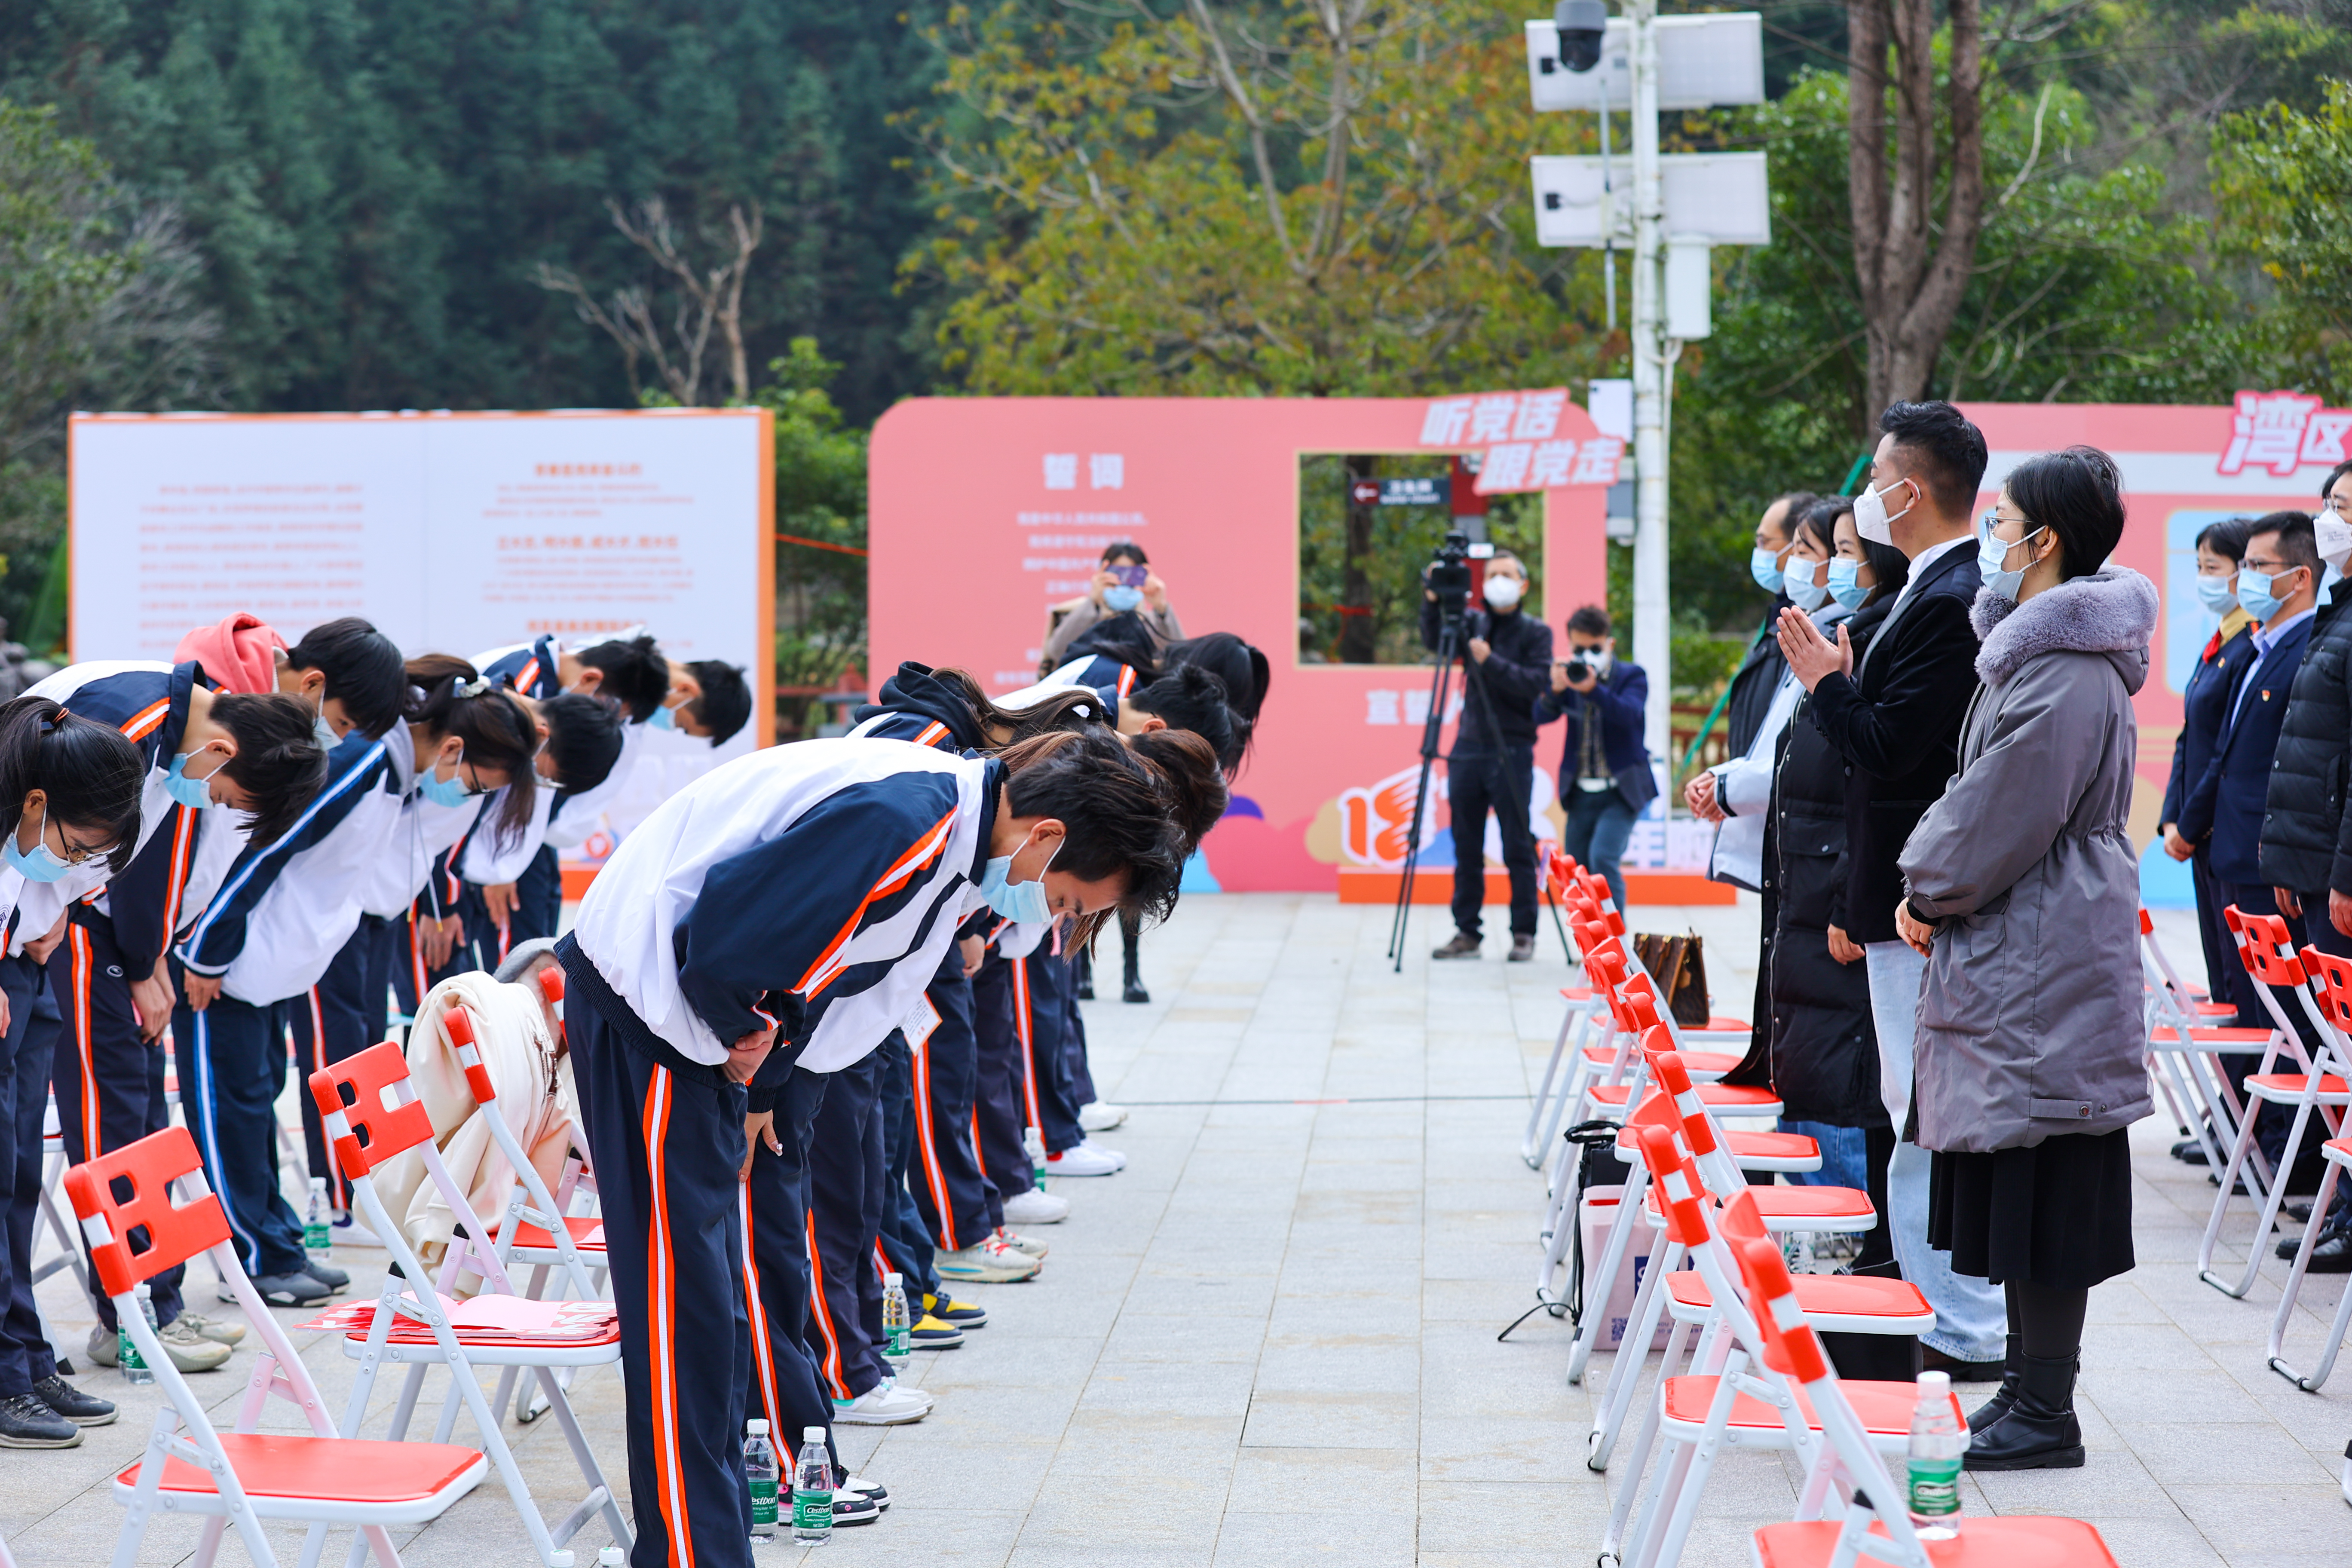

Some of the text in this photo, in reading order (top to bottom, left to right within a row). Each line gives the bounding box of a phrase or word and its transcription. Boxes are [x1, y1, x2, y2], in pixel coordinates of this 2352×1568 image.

[1420, 391, 1565, 446] 听党话
[2221, 395, 2352, 474] 湾区
[1477, 438, 1623, 490] 跟党走
